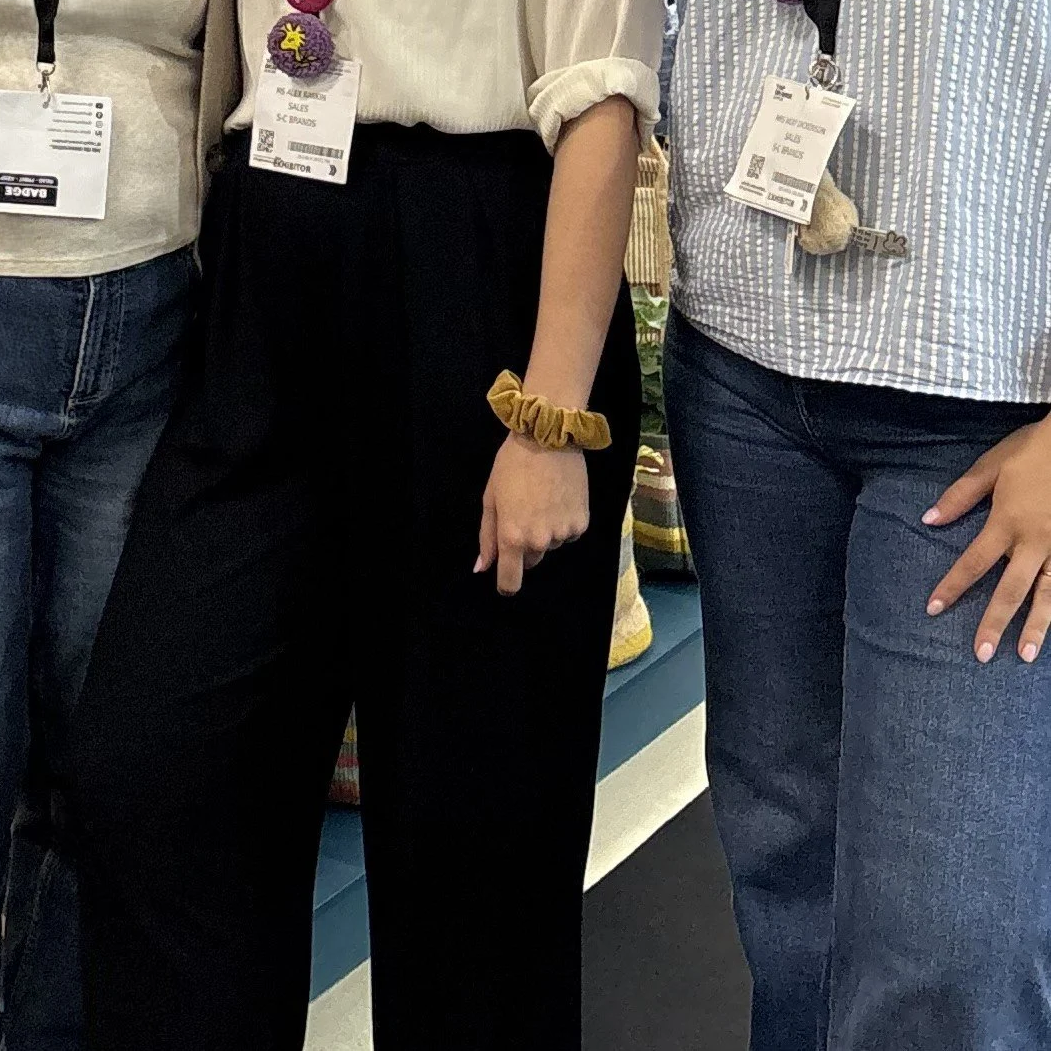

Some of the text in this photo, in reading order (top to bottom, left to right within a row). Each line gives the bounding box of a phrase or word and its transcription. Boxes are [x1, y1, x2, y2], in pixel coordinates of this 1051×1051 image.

[288, 102, 309, 113] SALES
[276, 113, 316, 127] S-C BRANDS
[4, 185, 48, 199] BADGE
